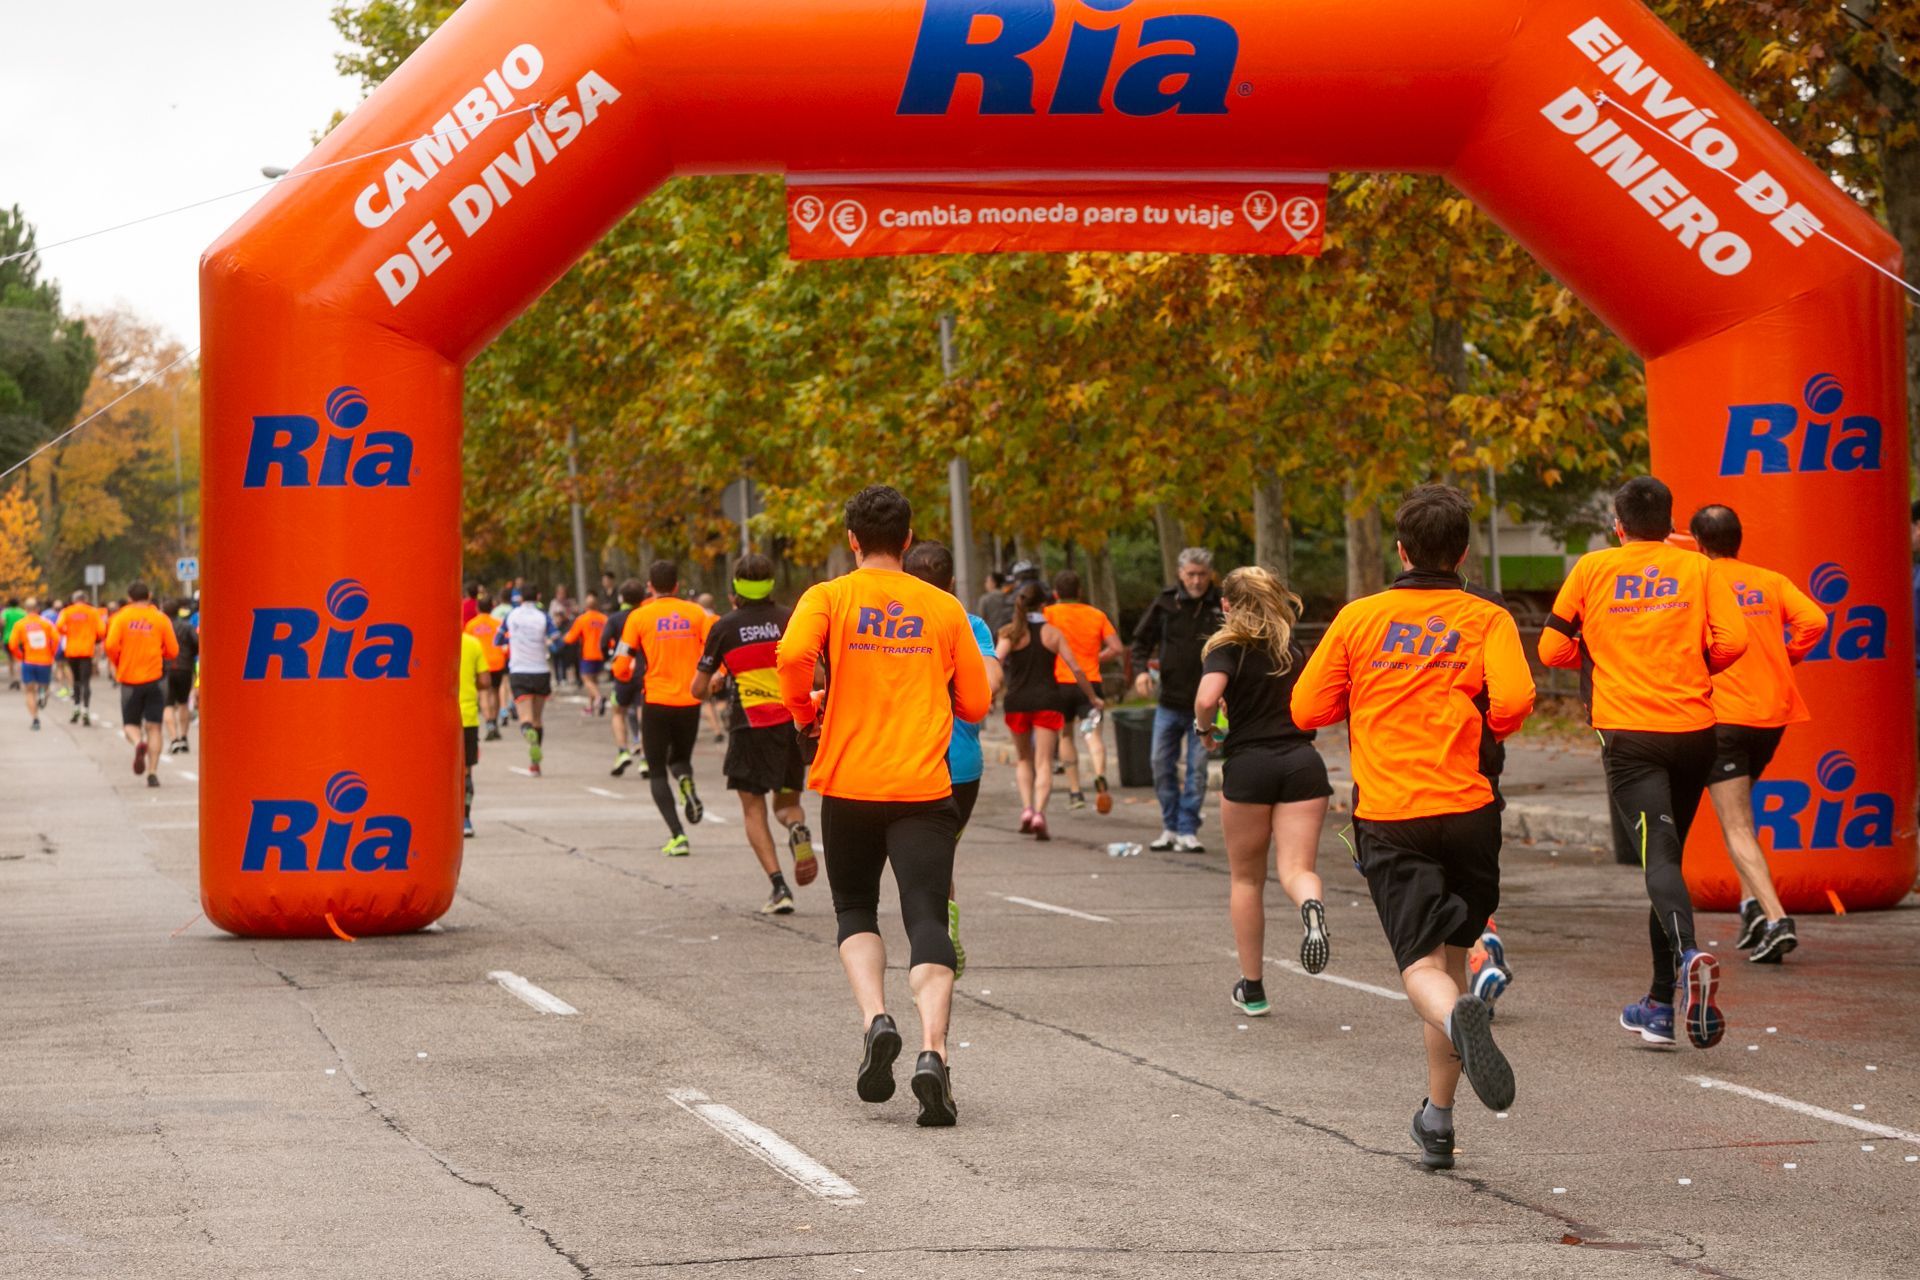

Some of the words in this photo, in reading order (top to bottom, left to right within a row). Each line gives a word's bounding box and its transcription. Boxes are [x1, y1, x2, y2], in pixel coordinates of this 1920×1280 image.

[895, 0, 1239, 116] Ria
[354, 43, 544, 228] CAMBIO
[1539, 86, 1752, 276] DINERO
[1567, 16, 1739, 170] ENVÍO
[1734, 169, 1825, 248] DE
[373, 220, 453, 307] DE
[448, 69, 623, 238] DIVISA
[878, 204, 972, 228] Cambia
[978, 203, 1078, 224] moneda
[1083, 206, 1138, 226] para
[1143, 205, 1169, 224] tu
[1174, 204, 1234, 229] viaje
[242, 385, 414, 488] Ria
[1718, 372, 1883, 477] Ria
[242, 578, 414, 680] Ria
[657, 611, 690, 632] Ria
[739, 621, 780, 642] ESPAÑA
[856, 600, 925, 638] Ria
[1609, 605, 1640, 614] MONEY
[1644, 601, 1690, 612] TRANSFER
[1614, 564, 1679, 600] Ria
[1733, 581, 1763, 607] ia
[1784, 562, 1888, 662] ia
[882, 645, 933, 655] TRANSFER
[1371, 659, 1411, 670] MONEY
[240, 770, 412, 873] Ria
[1751, 750, 1894, 850] Ria
